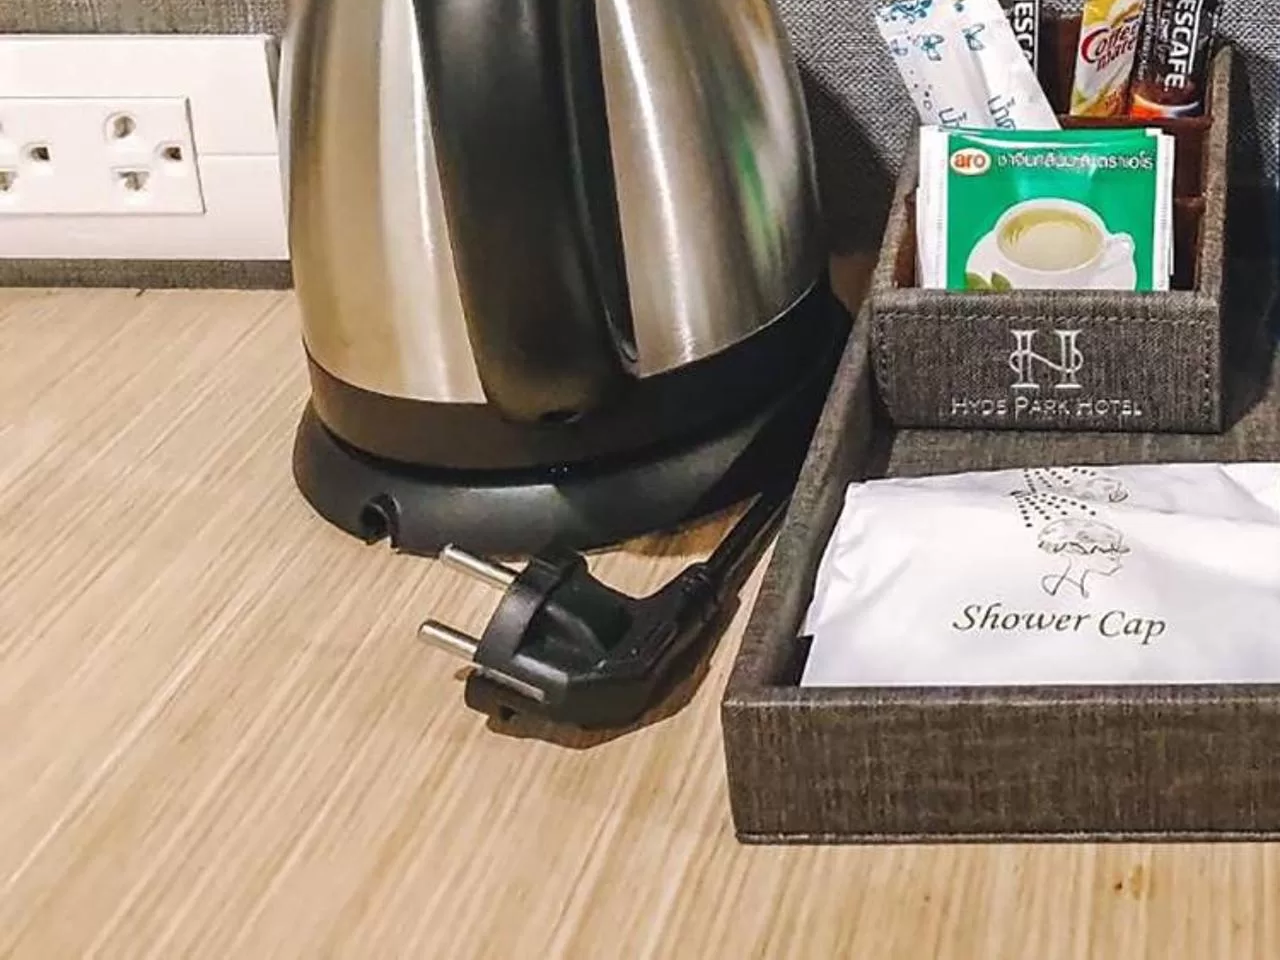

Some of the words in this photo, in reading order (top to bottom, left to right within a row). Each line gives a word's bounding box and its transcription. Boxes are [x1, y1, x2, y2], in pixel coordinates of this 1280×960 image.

[953, 153, 987, 168] aro
[1014, 396, 1070, 418] PARK
[1076, 397, 1143, 417] HOTEL
[952, 602, 1092, 631] Shower
[1099, 609, 1166, 646] Cap
